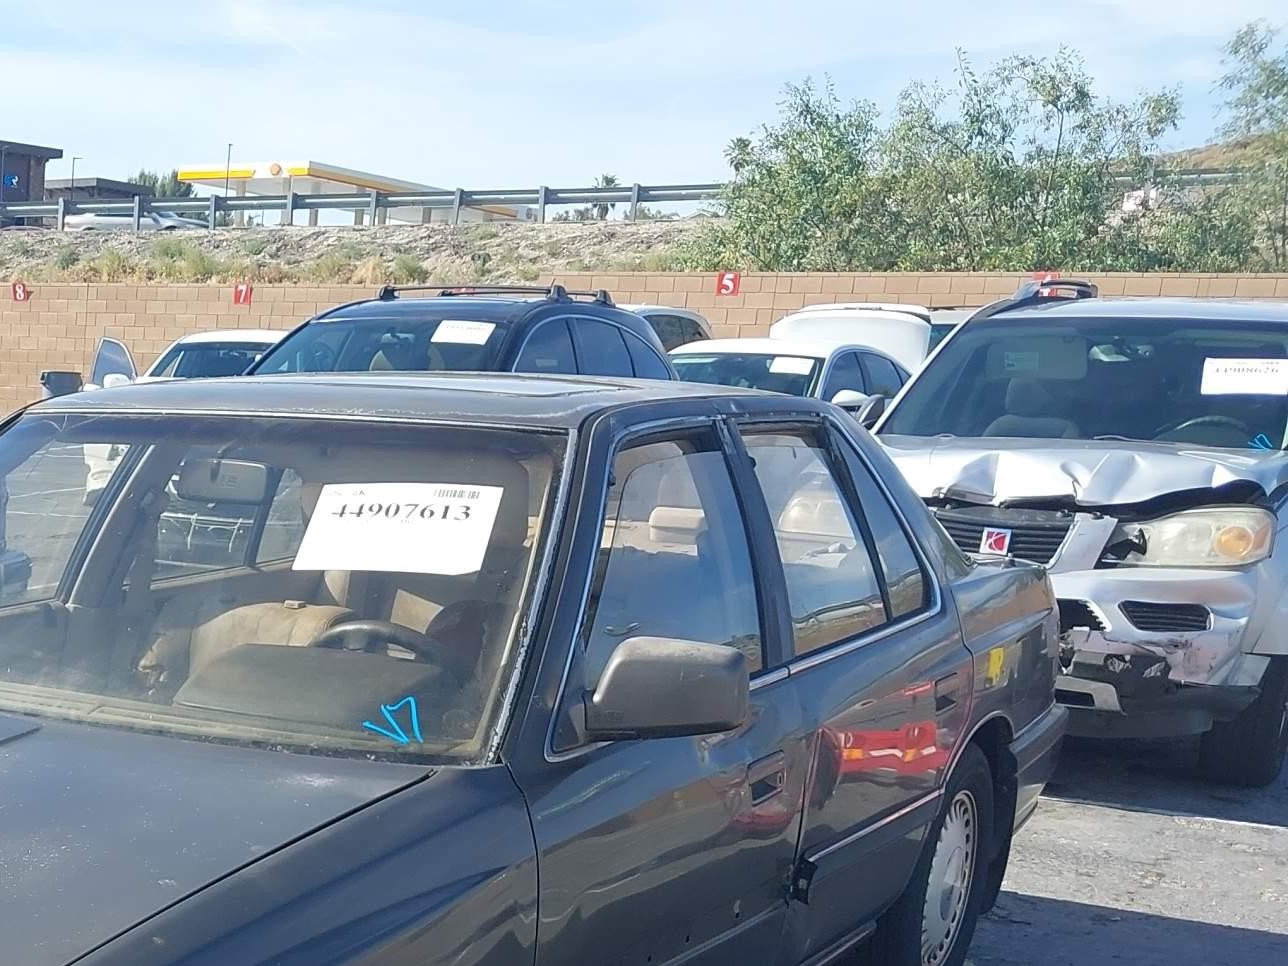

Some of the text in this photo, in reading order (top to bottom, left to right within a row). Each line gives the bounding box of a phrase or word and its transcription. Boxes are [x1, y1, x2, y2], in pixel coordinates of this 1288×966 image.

[15, 283, 25, 301] 8
[237, 283, 248, 303] 7
[720, 273, 735, 294] 5
[331, 502, 472, 521] 44907613
